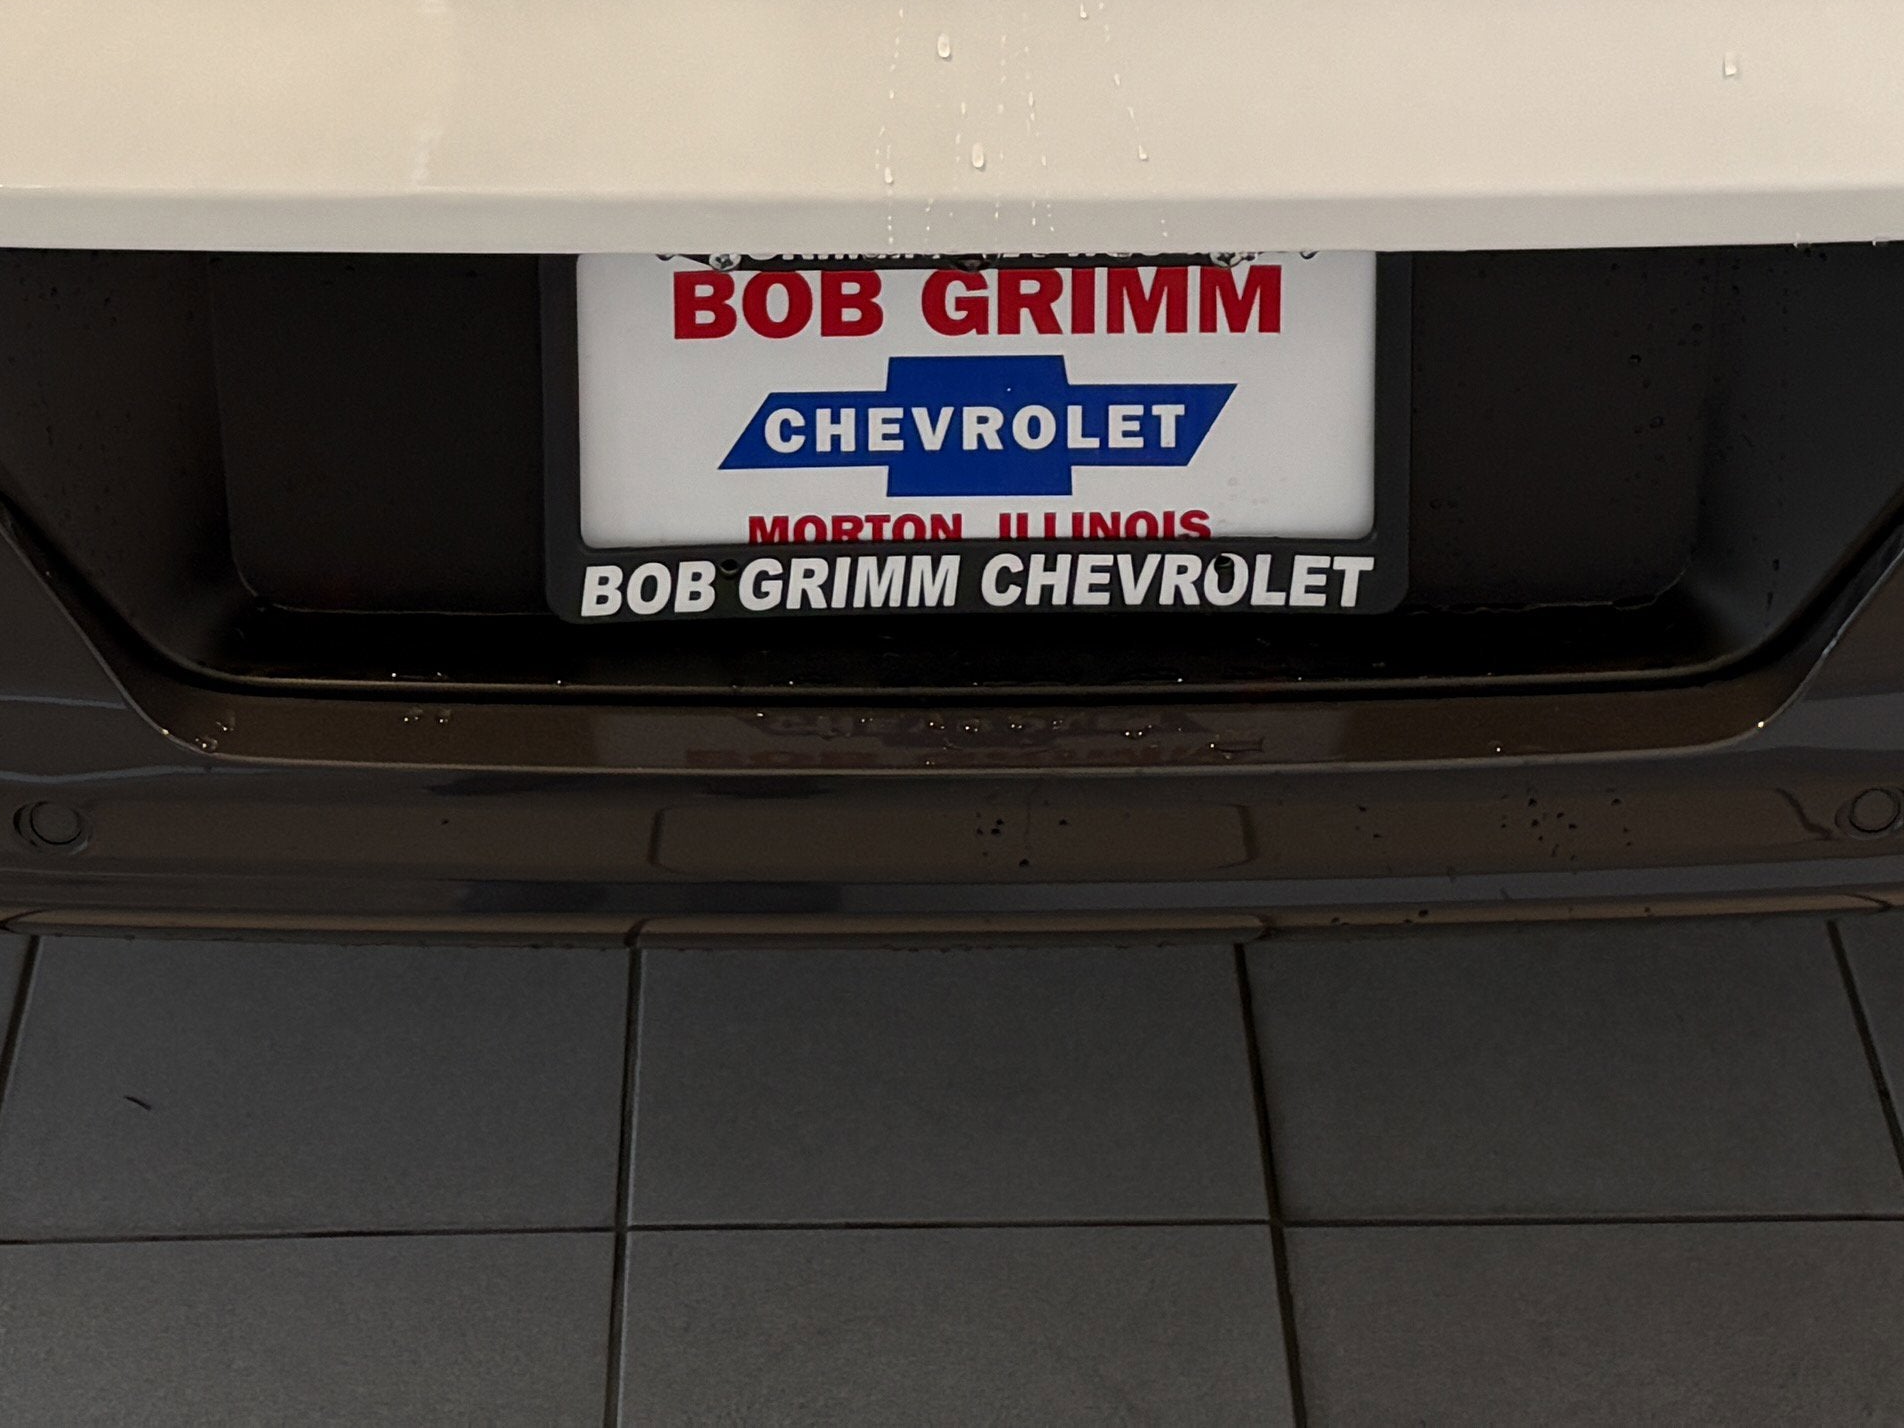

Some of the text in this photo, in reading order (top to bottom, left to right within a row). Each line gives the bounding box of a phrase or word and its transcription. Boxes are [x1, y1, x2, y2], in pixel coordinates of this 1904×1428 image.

[674, 265, 1282, 340] BOB GRIMM
[763, 404, 1186, 453] CHEVROLET
[748, 513, 963, 545] MORTON
[580, 551, 1374, 618] BOB GRIMM CHEVROLET
